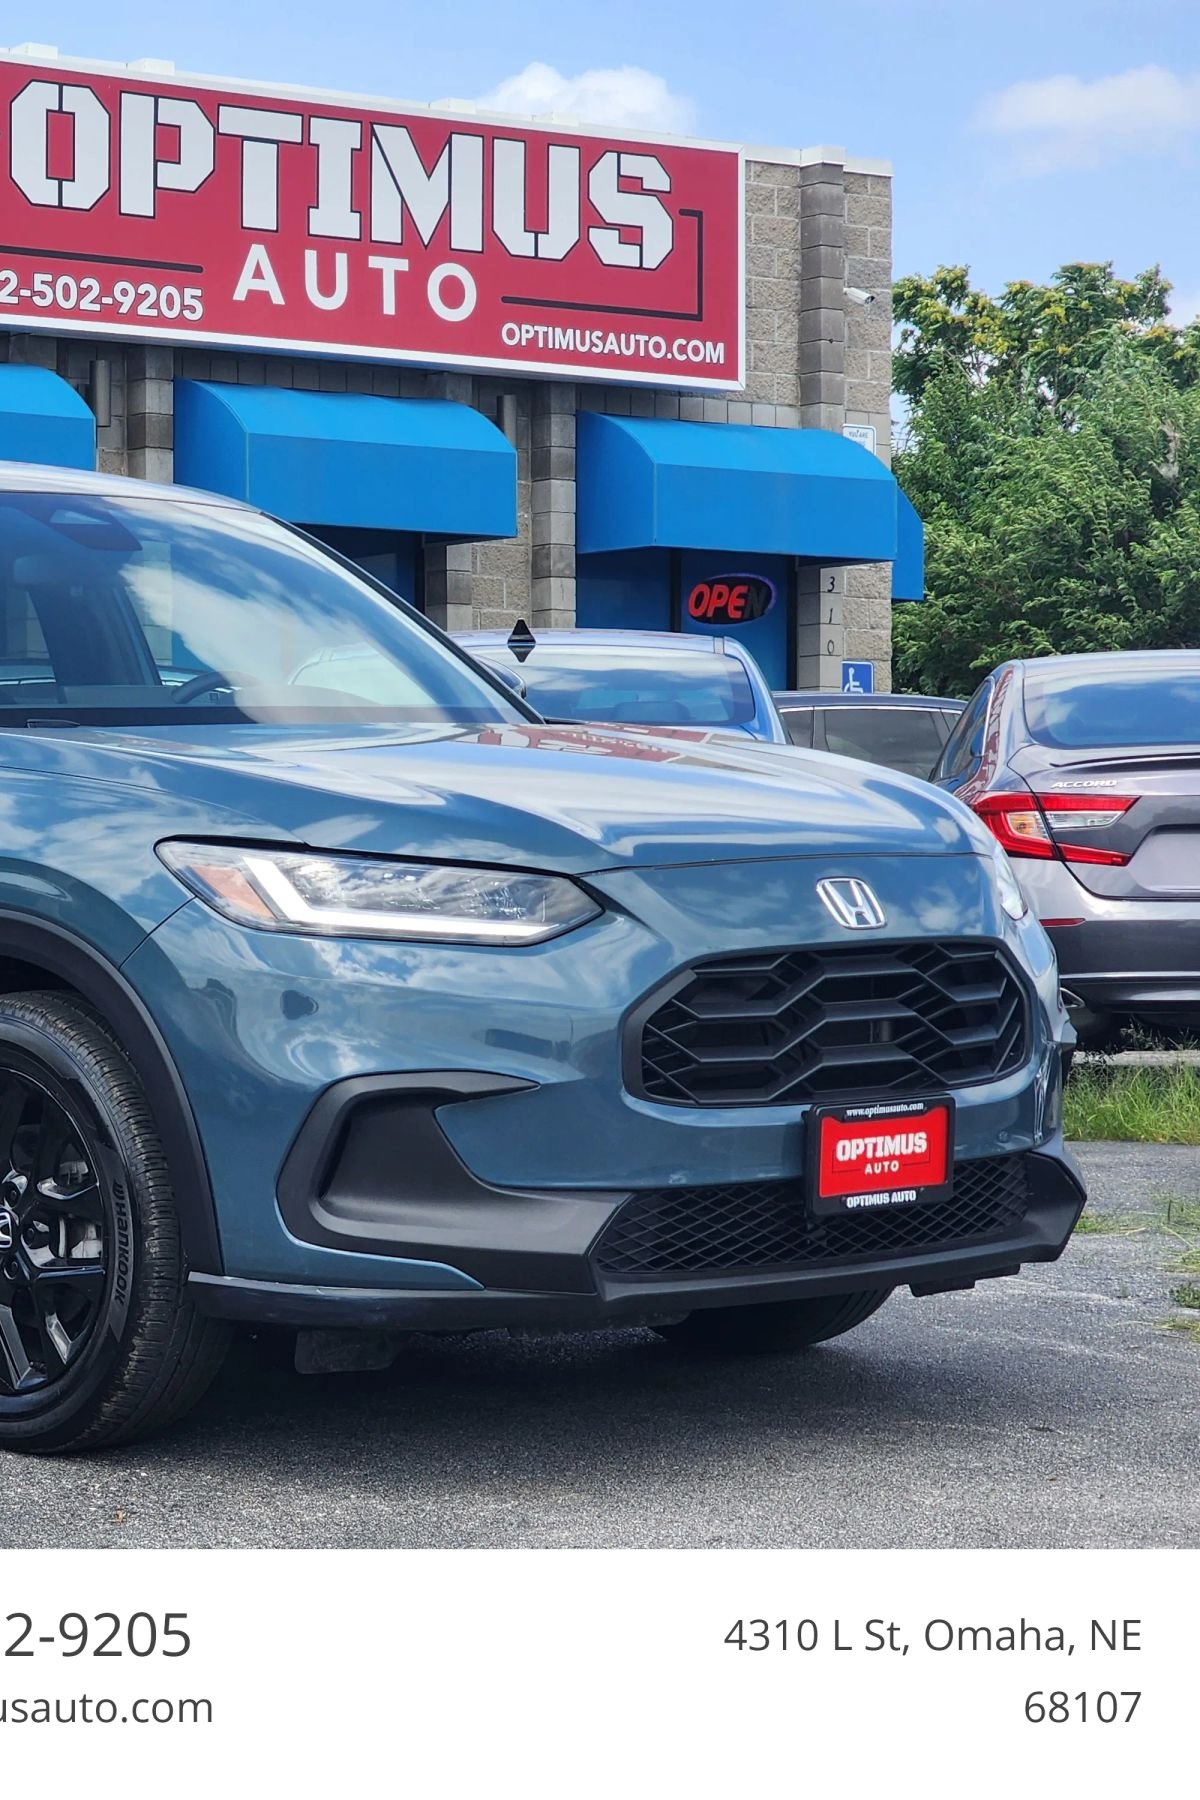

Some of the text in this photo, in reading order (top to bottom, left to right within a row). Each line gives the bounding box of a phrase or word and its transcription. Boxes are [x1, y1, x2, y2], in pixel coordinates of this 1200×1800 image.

[9, 79, 673, 271] OPTIMUS
[232, 243, 477, 322] AUTO
[501, 322, 725, 364] OPTIMUSAUTO.COM
[688, 583, 768, 619] OPEN
[1050, 780, 1117, 789] ACCORD
[846, 1102, 924, 1118] www.optimusauto.com
[836, 1131, 928, 1162] OPTIMUS
[864, 1160, 900, 1175] AUTO
[846, 1190, 917, 1209] OPTIMUS AUTO
